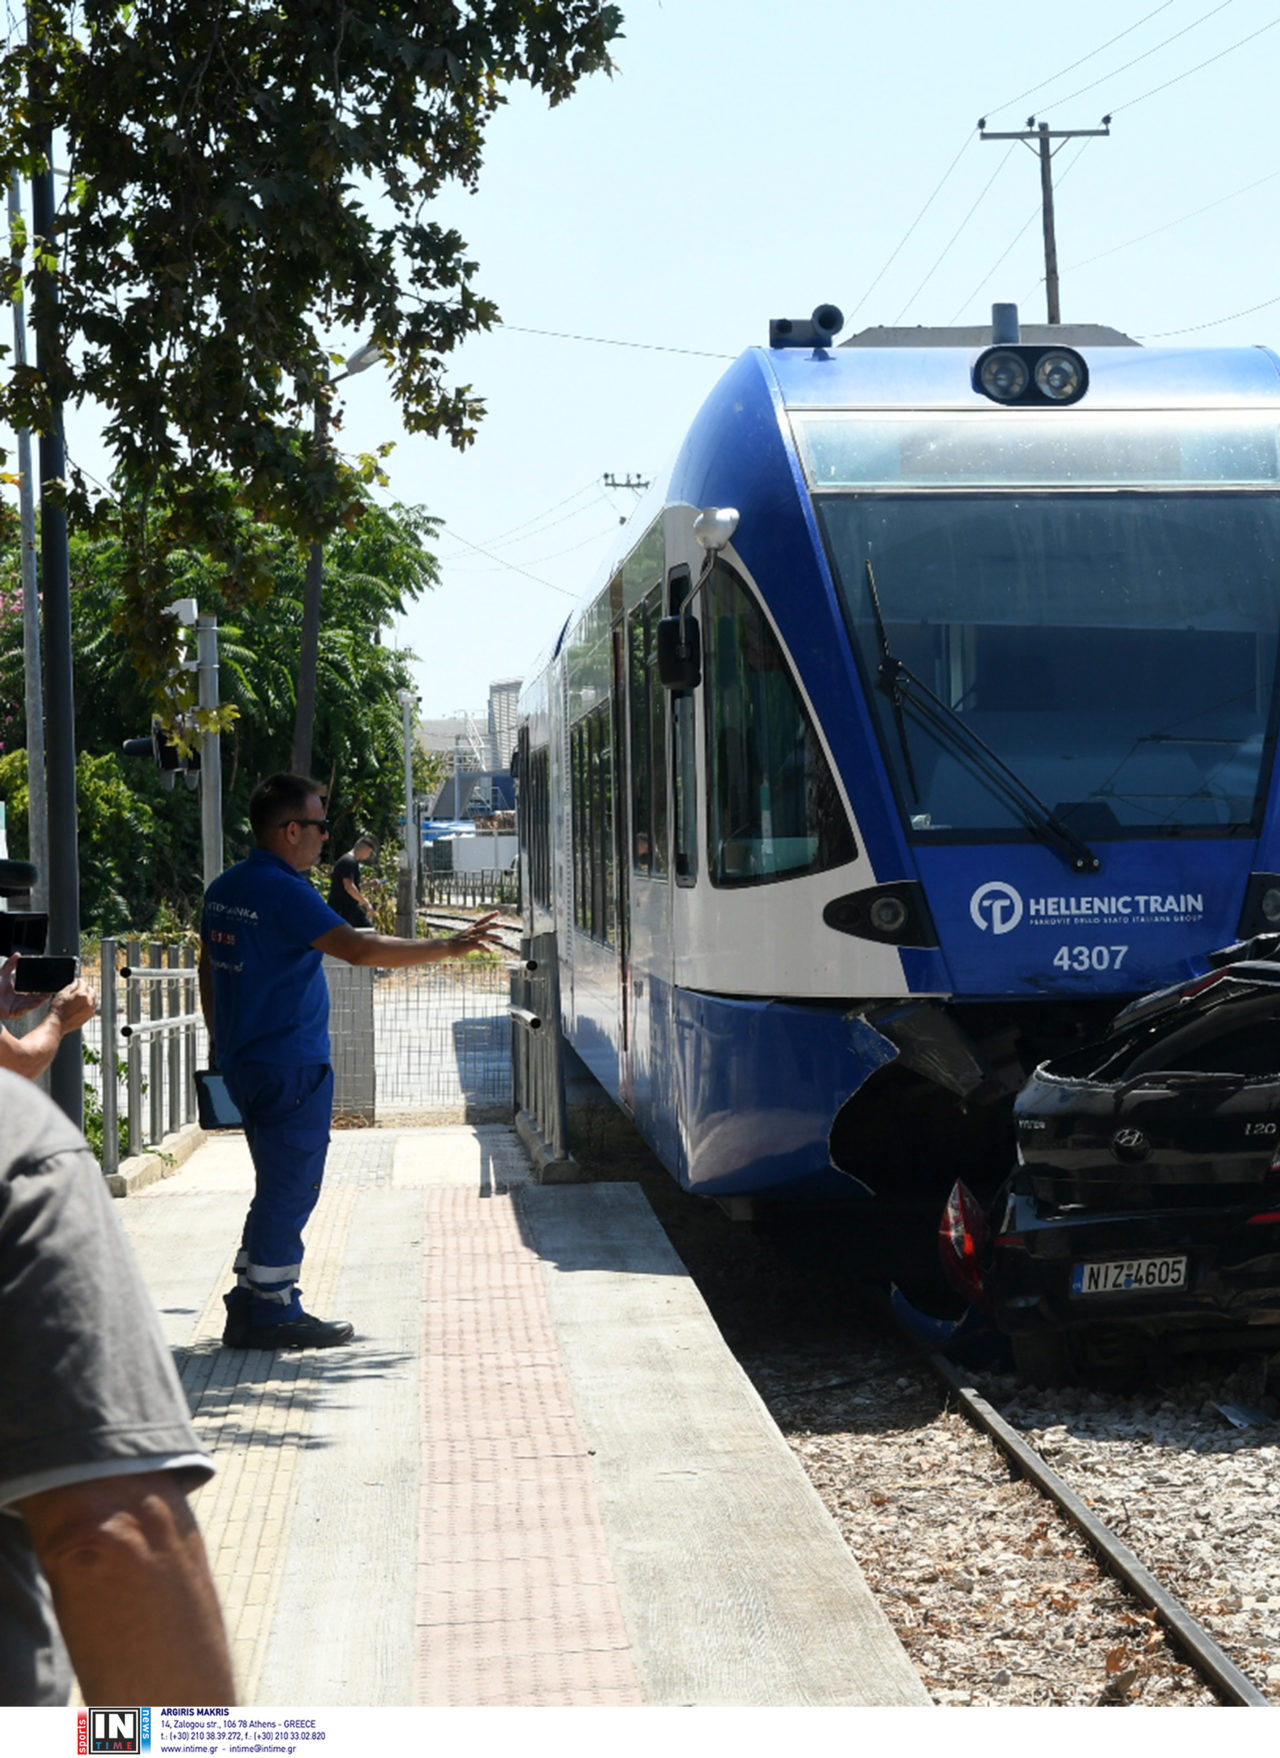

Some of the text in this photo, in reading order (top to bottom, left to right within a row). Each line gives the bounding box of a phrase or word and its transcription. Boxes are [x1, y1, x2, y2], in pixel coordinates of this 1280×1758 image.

[1030, 894, 1203, 916] HELLENIC TRAIN
[1053, 946, 1129, 971] 4307
